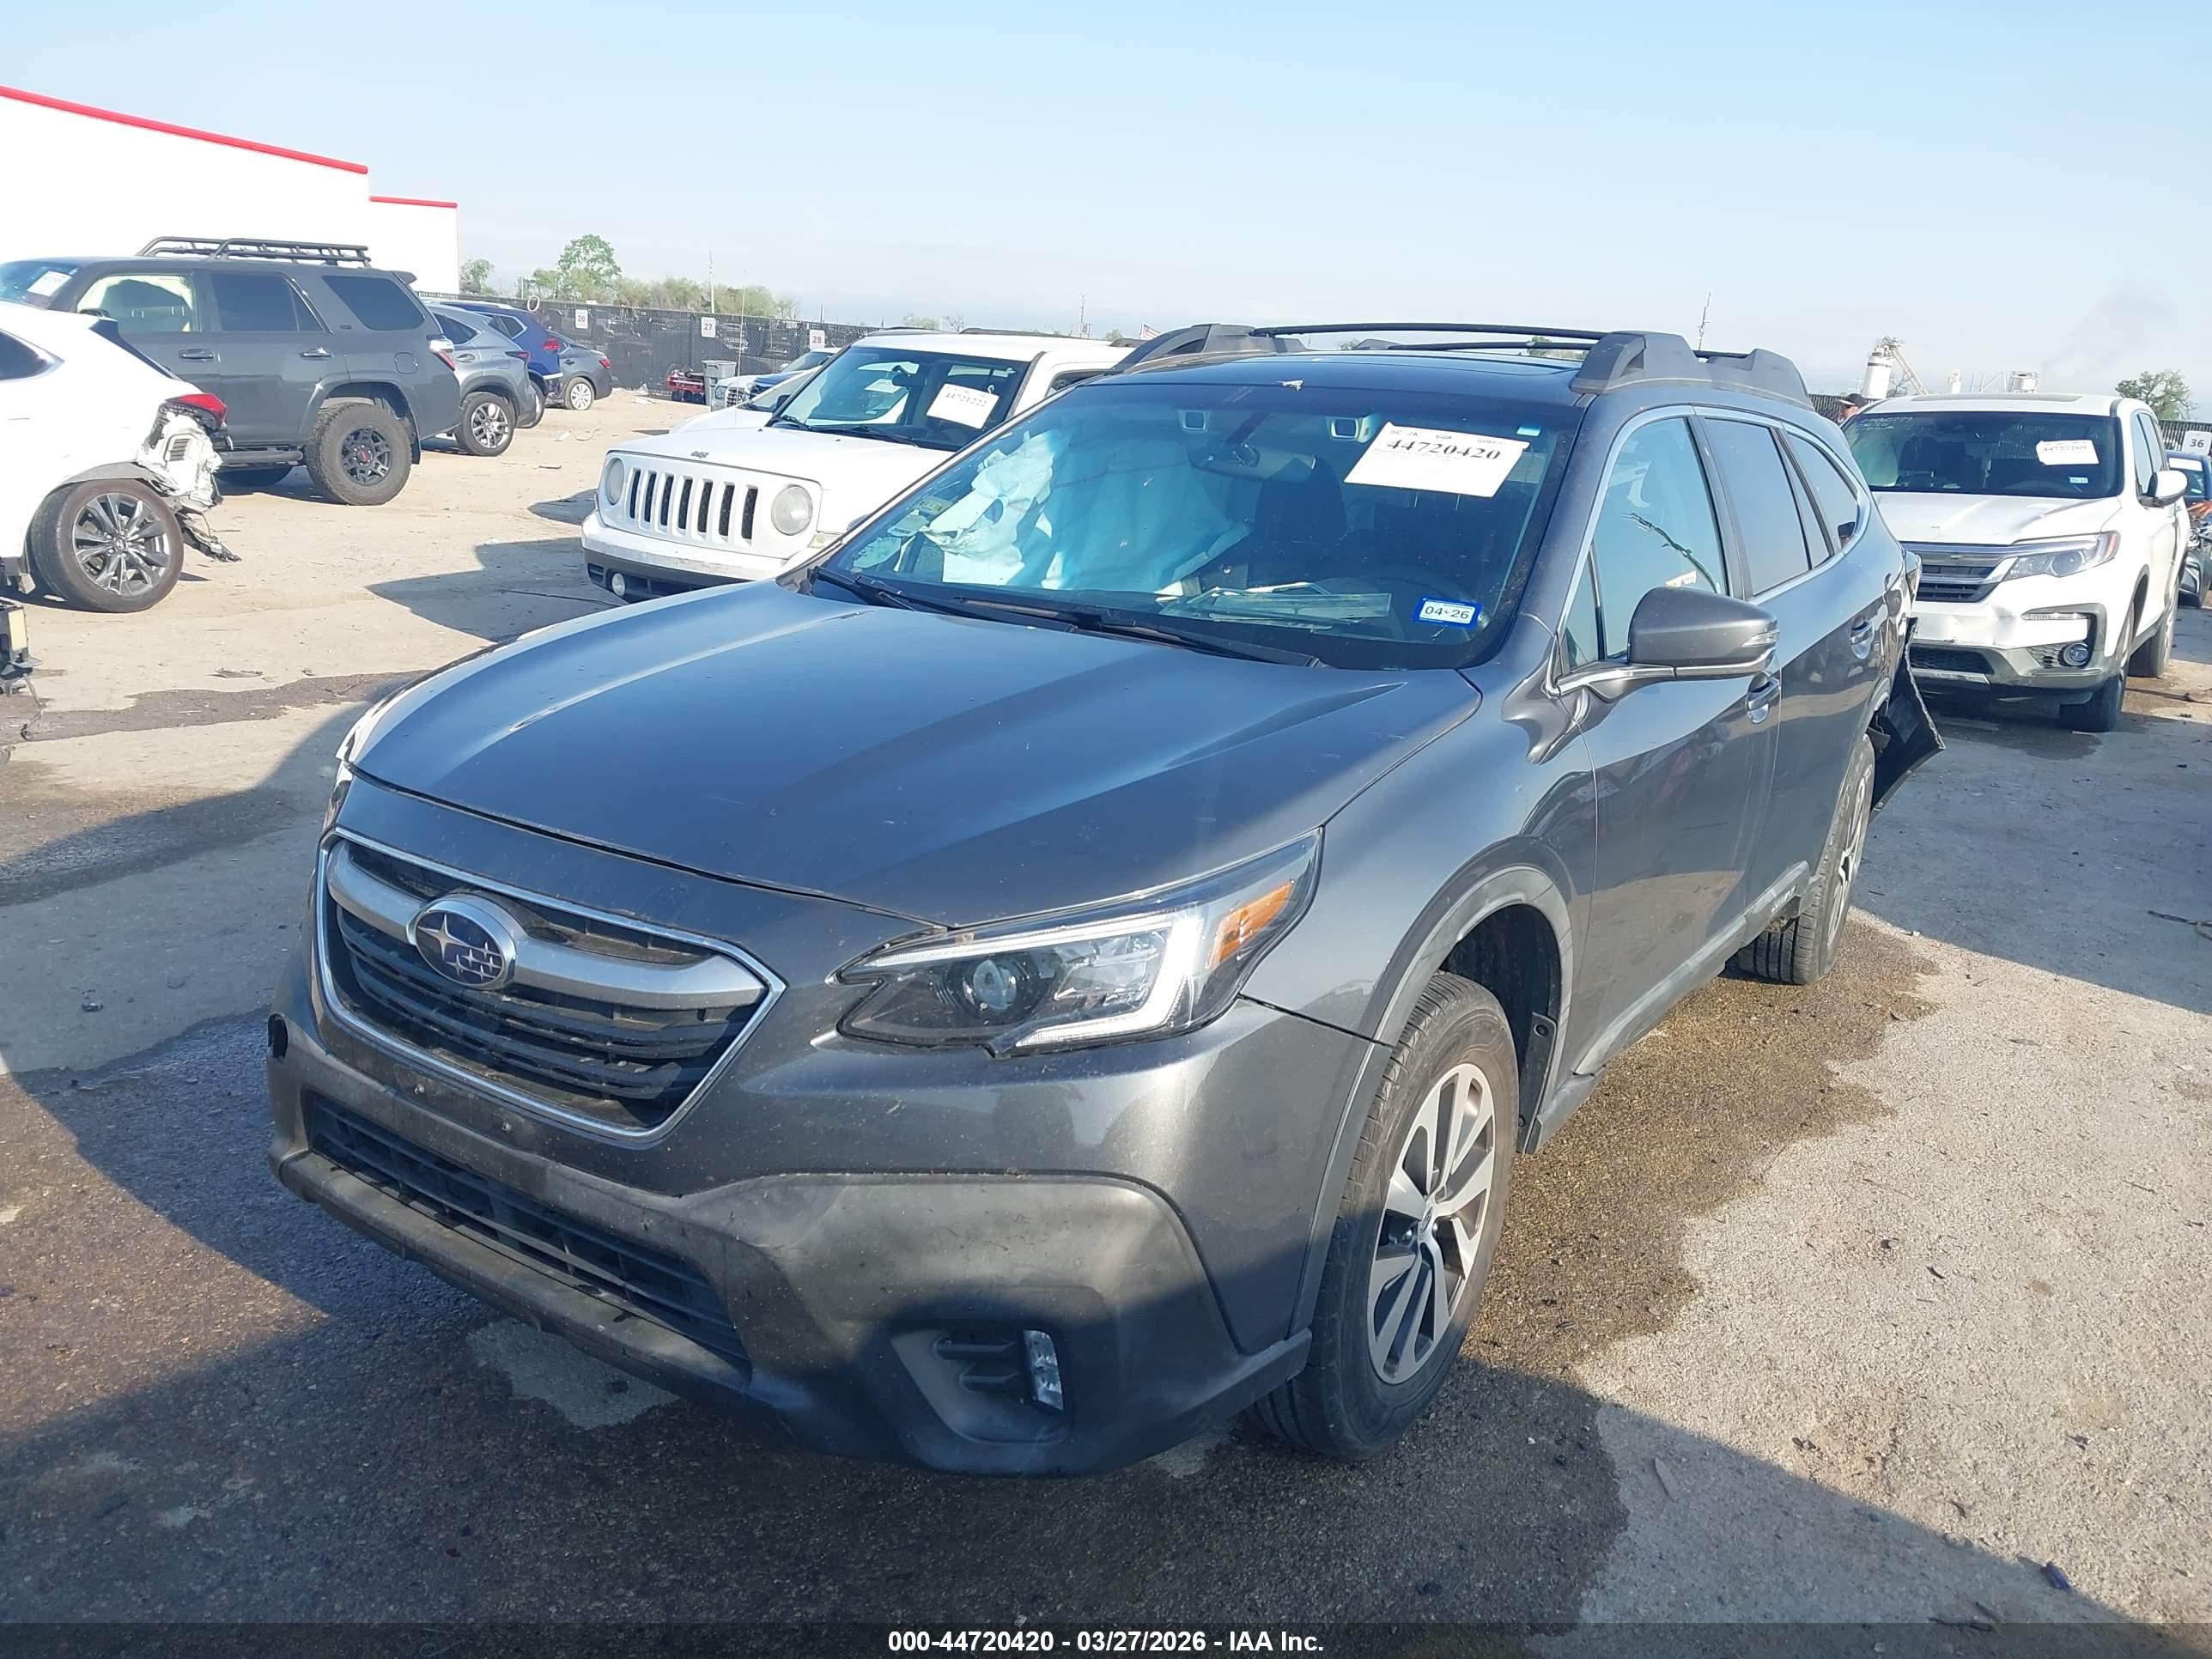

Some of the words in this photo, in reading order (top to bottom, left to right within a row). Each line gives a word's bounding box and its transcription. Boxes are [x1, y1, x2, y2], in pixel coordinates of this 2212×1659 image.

[703, 322, 713, 331] 27
[811, 336, 823, 344] 28
[2190, 438, 2205, 448] 36
[1386, 439, 1502, 461] 44720420
